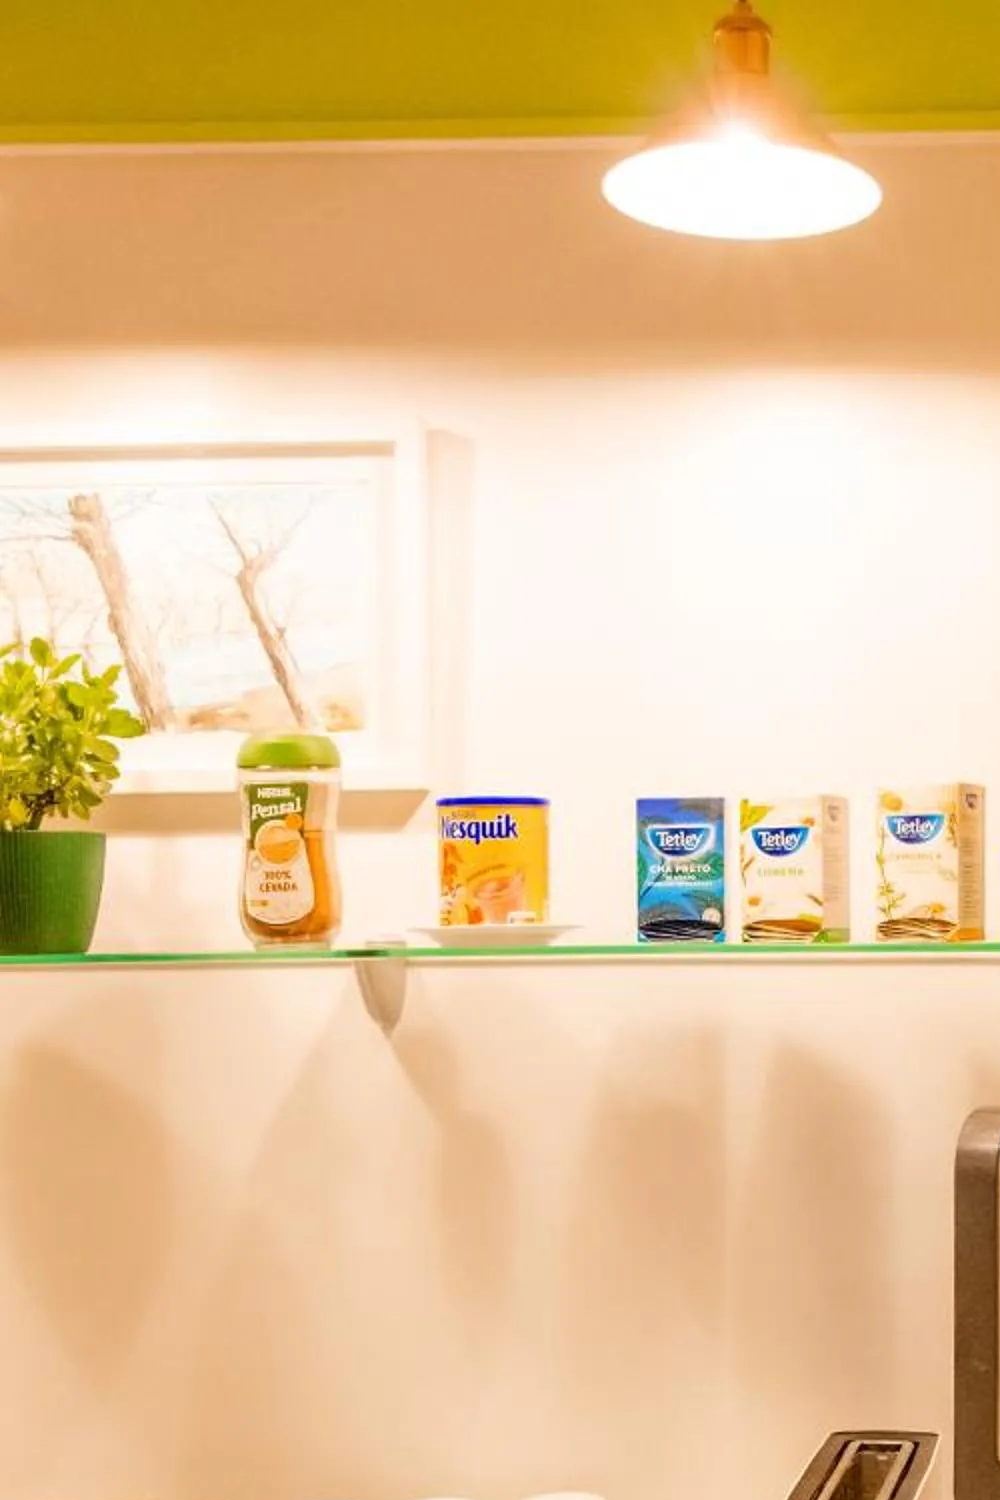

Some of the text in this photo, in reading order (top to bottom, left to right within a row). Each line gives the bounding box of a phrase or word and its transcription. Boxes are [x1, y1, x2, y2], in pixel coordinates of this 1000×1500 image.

[251, 797, 302, 820] Pensal
[441, 814, 519, 845] Nesquik
[892, 817, 938, 839] Tetley
[656, 830, 705, 851] Tetley
[758, 829, 803, 851] Tetley
